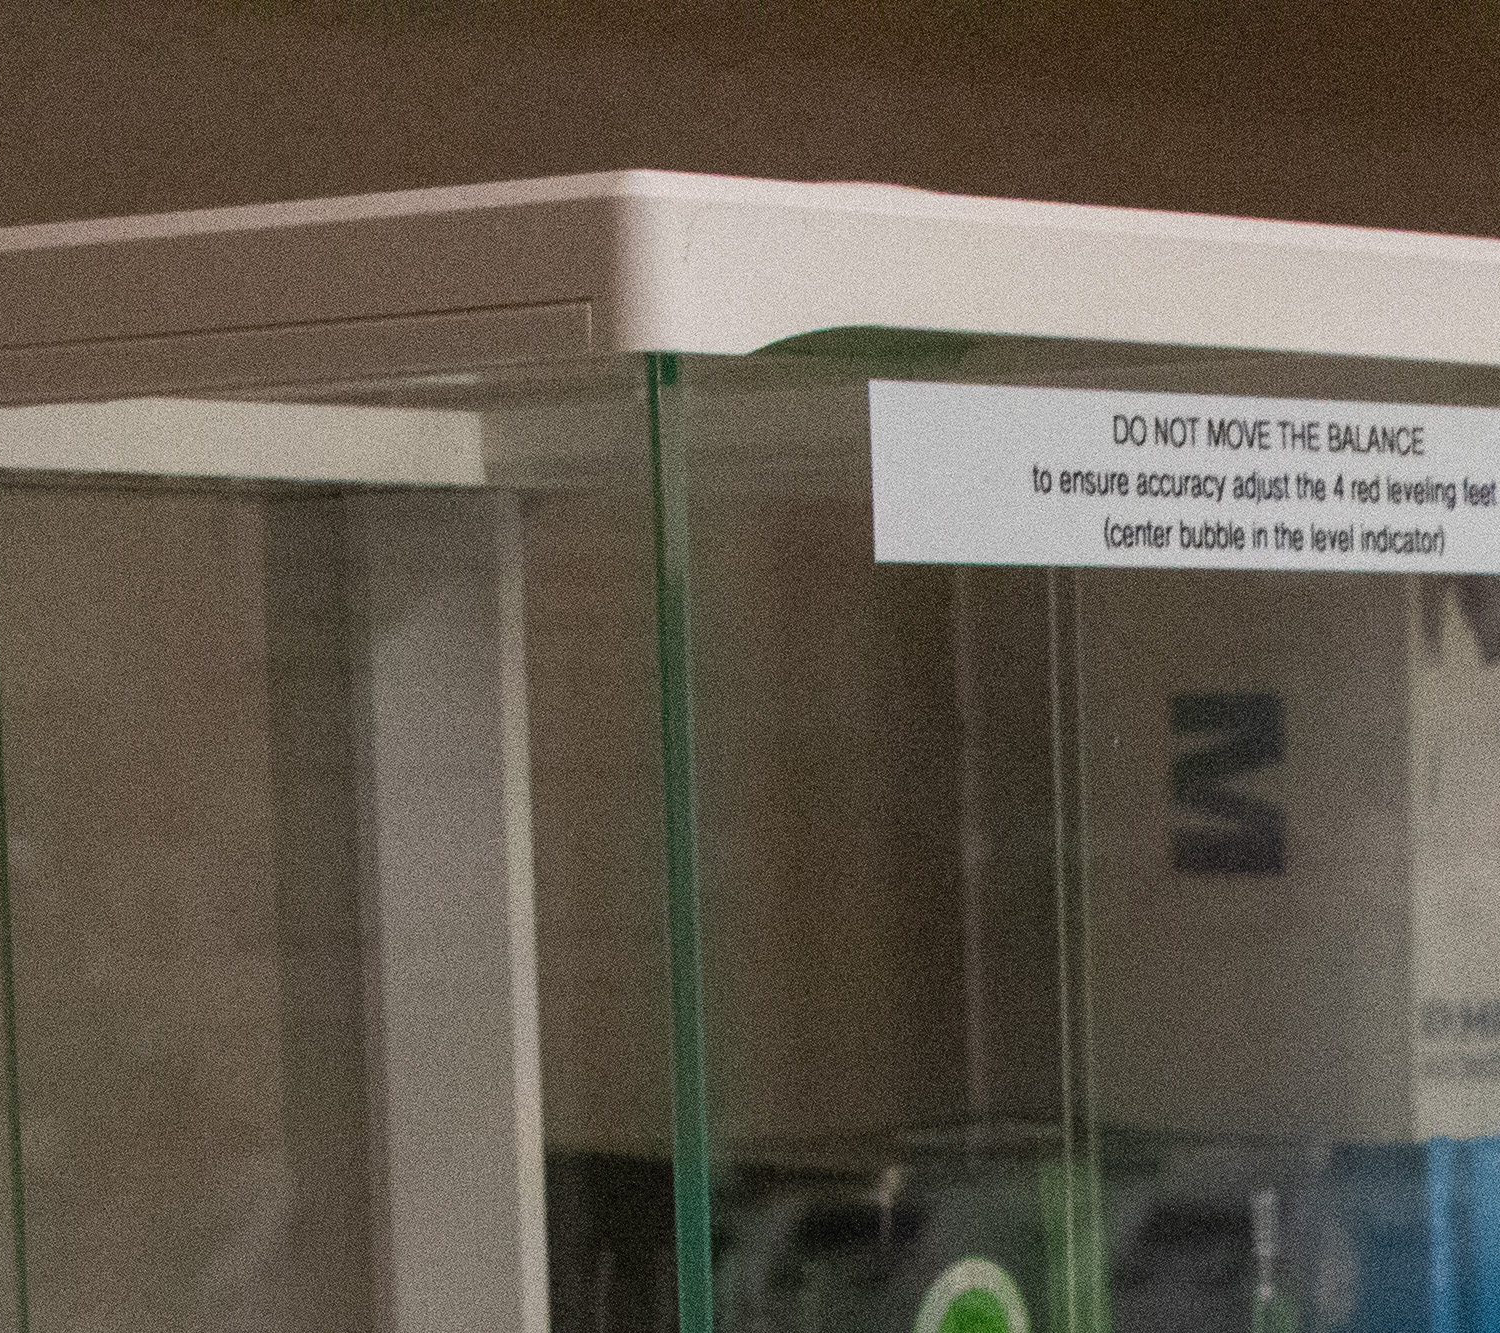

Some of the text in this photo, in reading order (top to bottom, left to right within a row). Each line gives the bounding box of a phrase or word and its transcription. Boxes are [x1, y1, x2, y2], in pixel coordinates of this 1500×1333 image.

[1113, 414, 1425, 457] DO NOT MOVE THE BALANCE
[1032, 465, 1497, 510] to ensure accuracy adjust the 4 red leveling feet
[1103, 518, 1446, 558] (center bubble in the level indicator)
